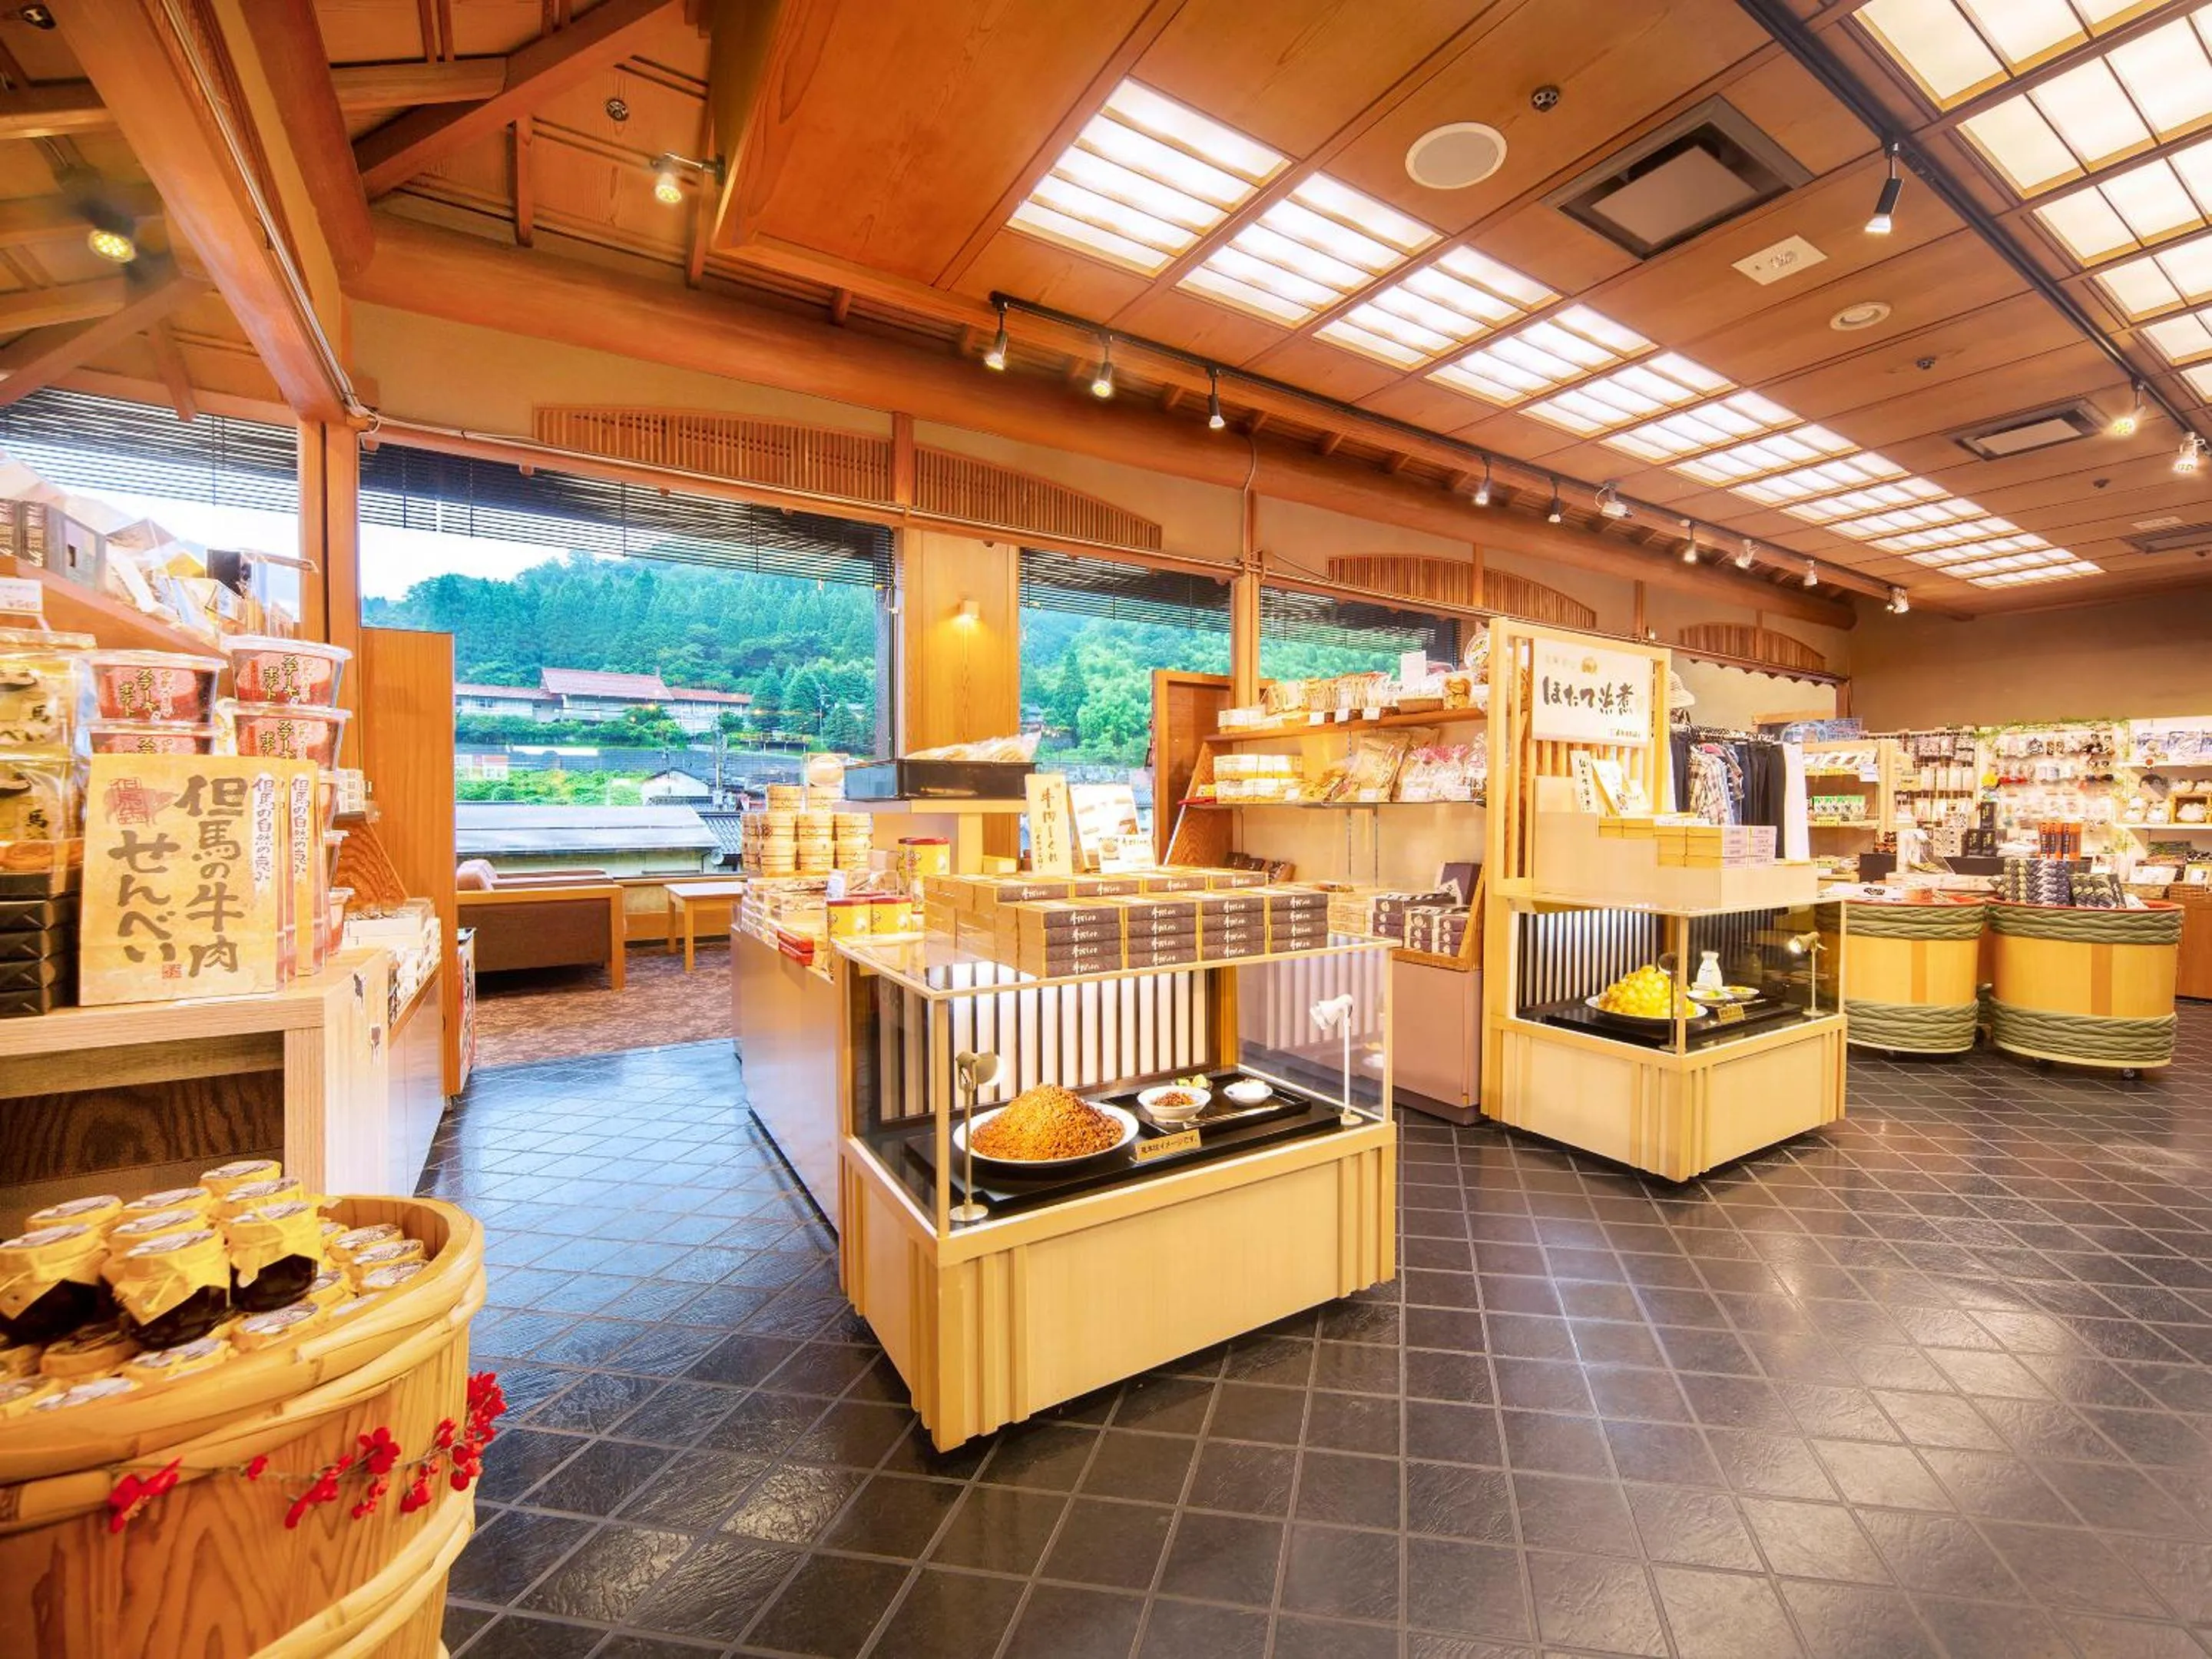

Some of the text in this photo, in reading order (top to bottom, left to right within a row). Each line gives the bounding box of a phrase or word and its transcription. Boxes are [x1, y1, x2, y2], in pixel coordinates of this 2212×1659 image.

[108, 830, 181, 963] せんべい
[174, 774, 248, 979] 但馬の牛肉
